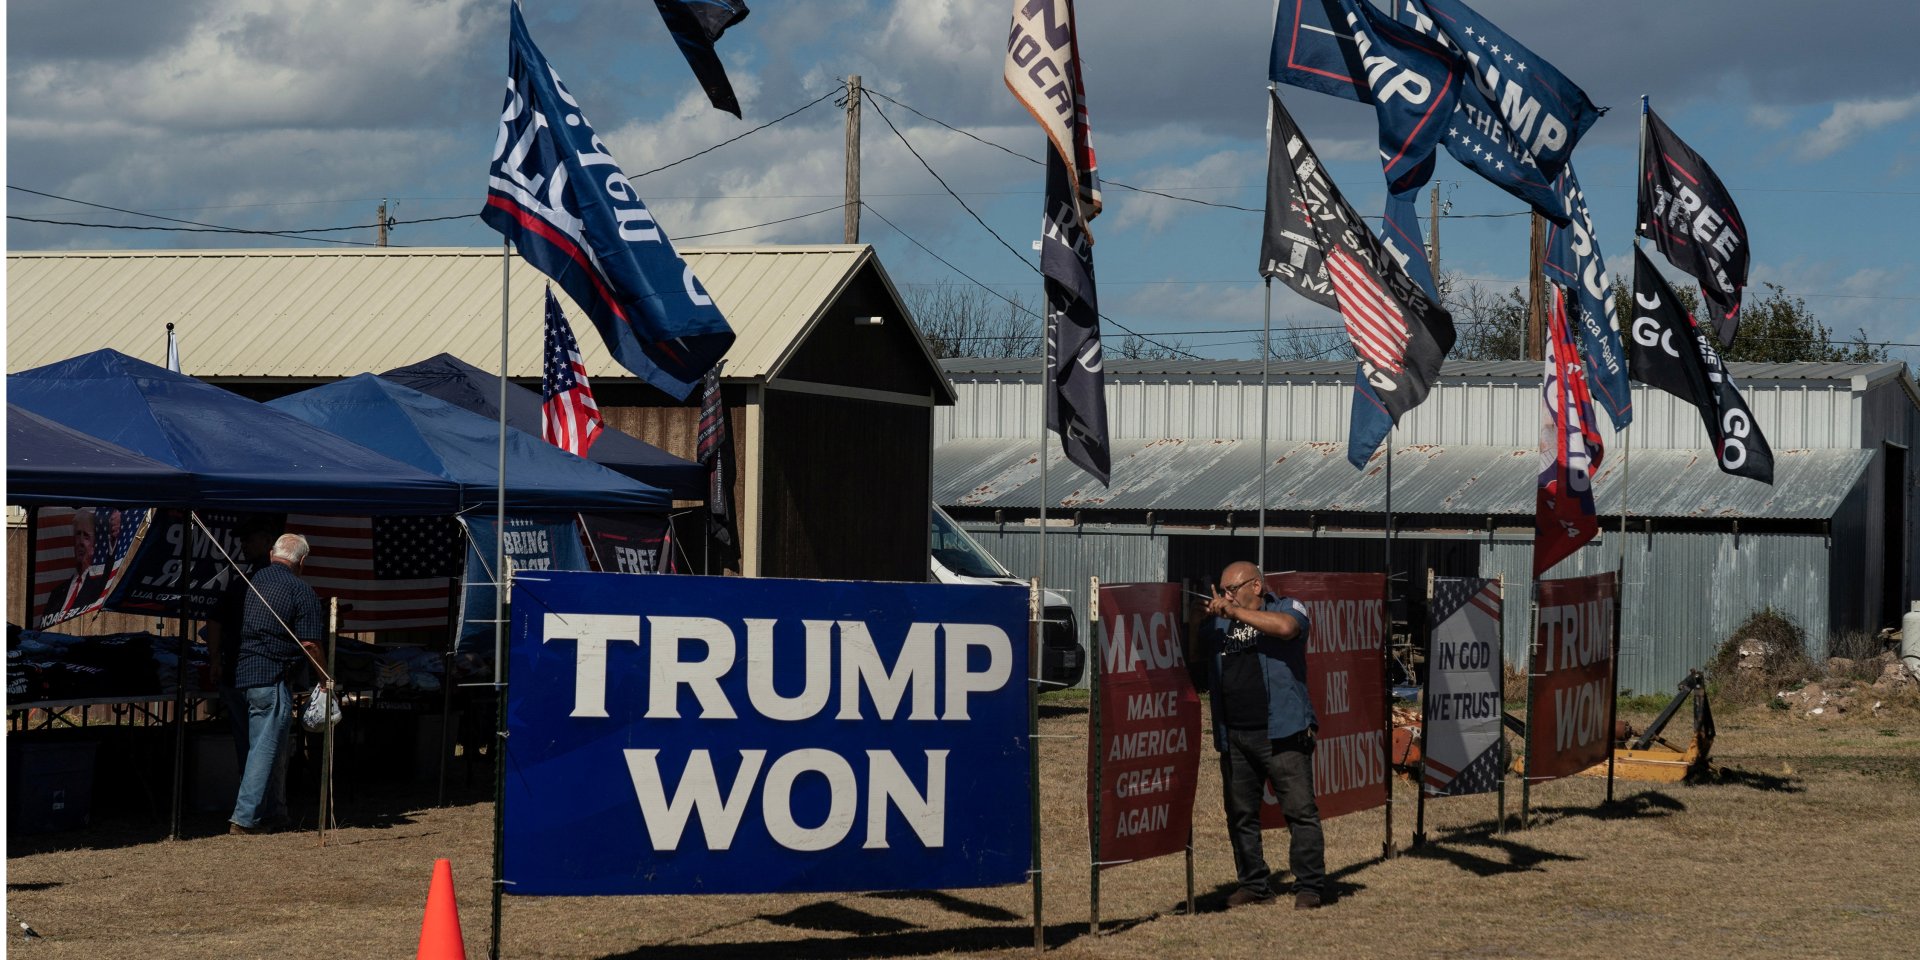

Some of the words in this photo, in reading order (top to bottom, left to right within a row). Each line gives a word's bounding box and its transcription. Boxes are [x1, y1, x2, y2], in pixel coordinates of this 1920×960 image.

[1466, 103, 1503, 144] THE
[1599, 331, 1621, 376] Again
[503, 530, 549, 554] BRING
[1099, 611, 1187, 675] MAGA
[1306, 598, 1383, 654] EMOCRATS
[542, 612, 1013, 721] TRUMP
[1439, 641, 1455, 670] IN
[1459, 641, 1490, 670] GOD
[1126, 690, 1178, 722] MAKE
[1325, 670, 1350, 716] ARE
[1428, 692, 1449, 721] WE
[1454, 691, 1500, 720] TRUST
[1554, 676, 1607, 752] WON
[1108, 726, 1188, 762] AMERICA
[622, 748, 950, 852] WON
[1116, 765, 1175, 799] GREAT
[1115, 803, 1170, 839] AGAIN
